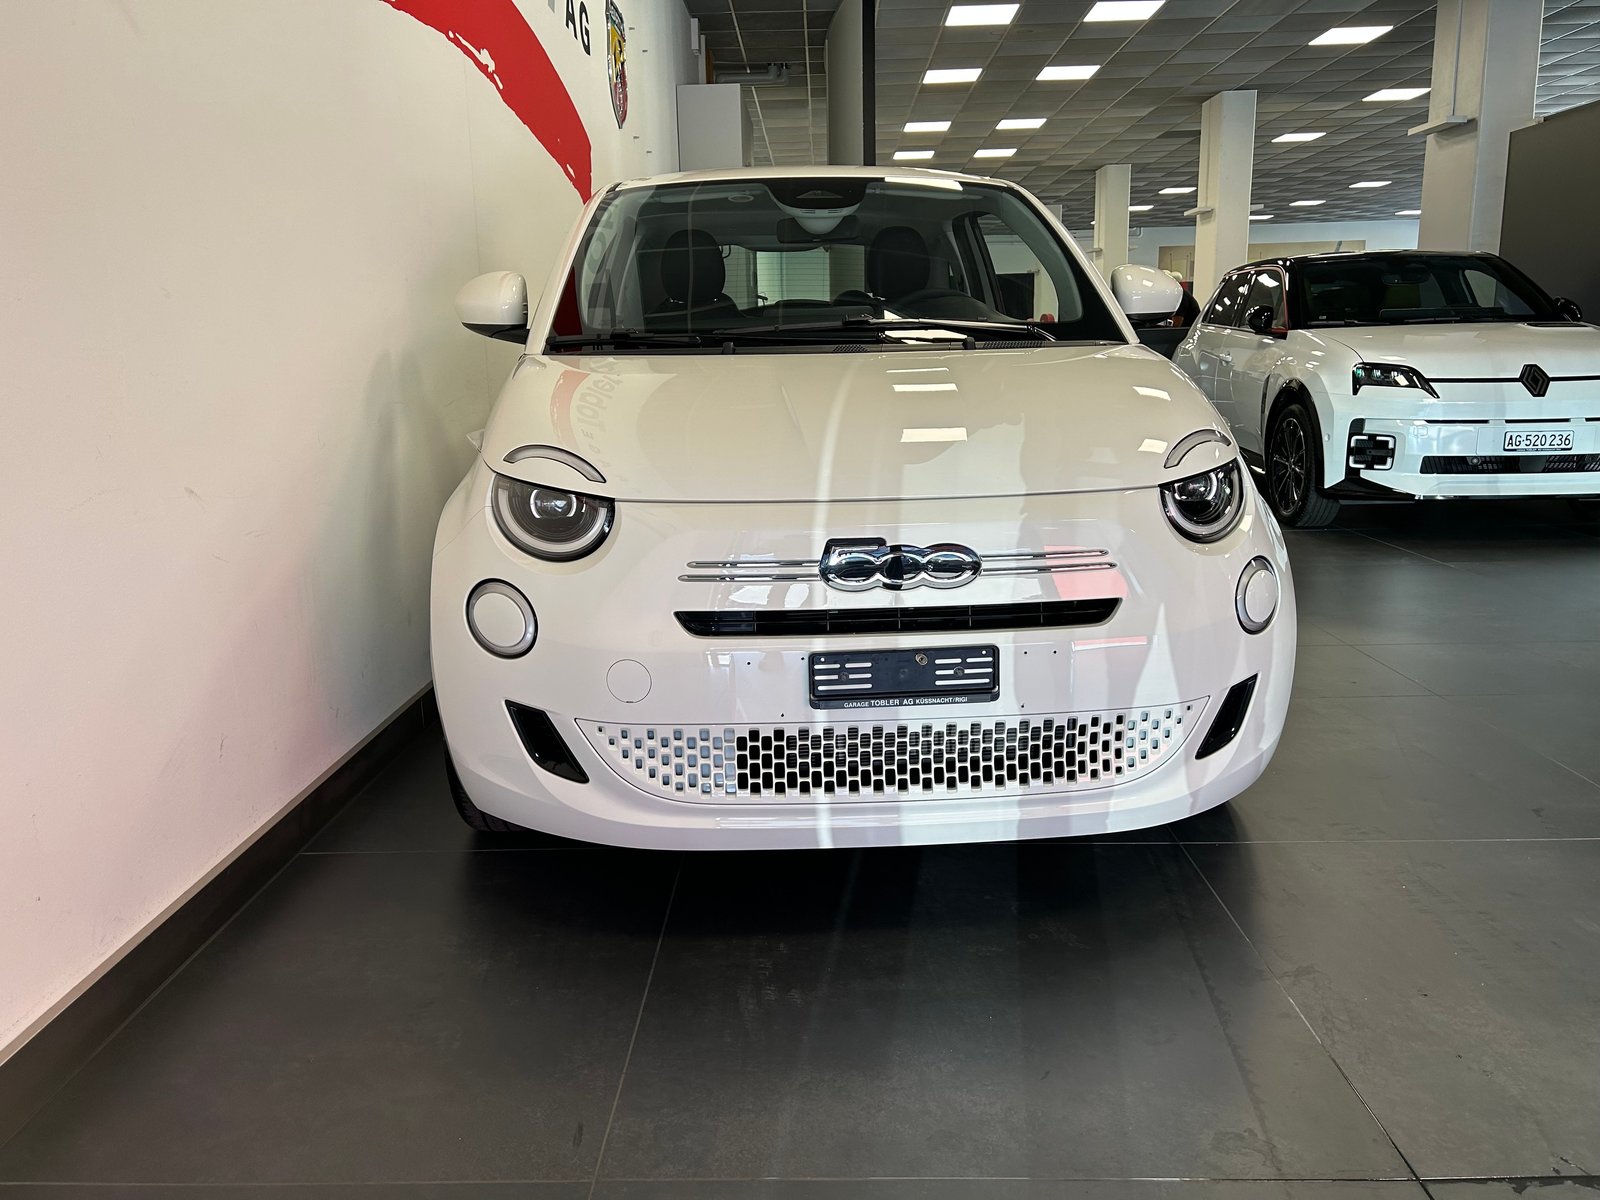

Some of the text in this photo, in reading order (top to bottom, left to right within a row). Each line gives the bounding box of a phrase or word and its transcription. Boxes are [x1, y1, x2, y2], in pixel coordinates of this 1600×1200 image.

[565, 0, 591, 56] AG
[819, 536, 983, 592] 500
[870, 699, 900, 707] TOBLER
[915, 696, 968, 705] KÜSSNACHT/RIGI
